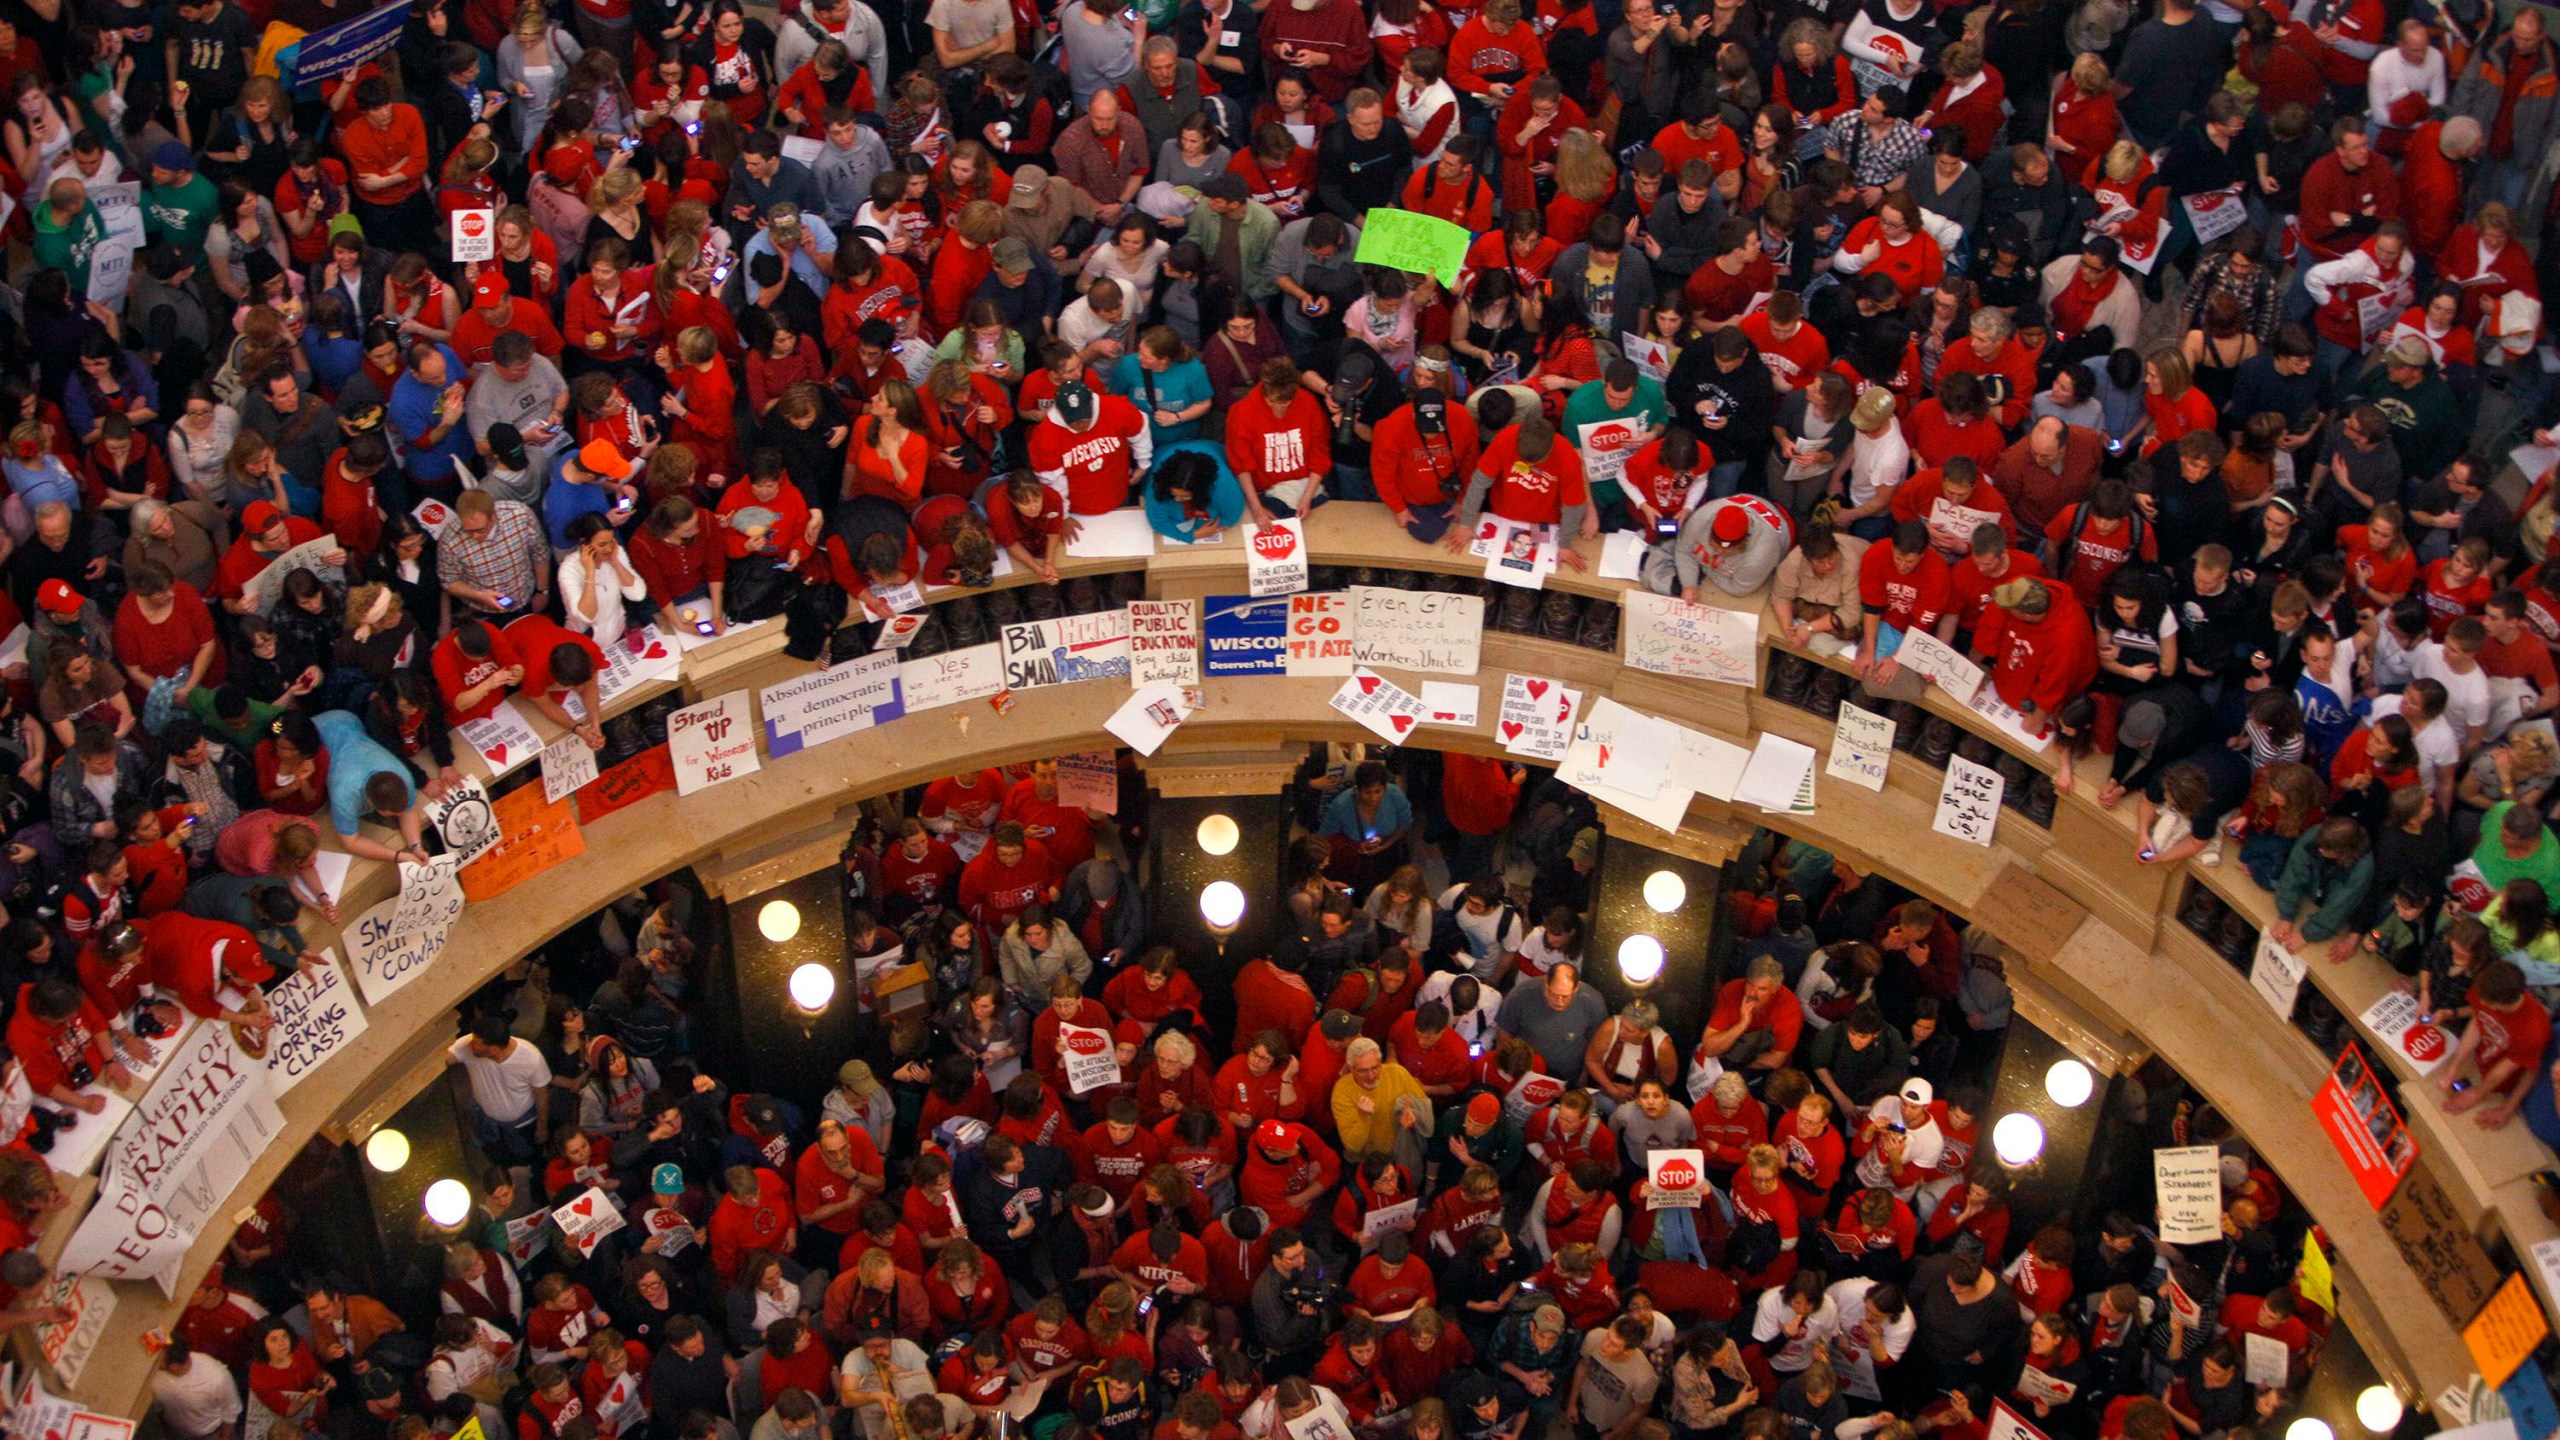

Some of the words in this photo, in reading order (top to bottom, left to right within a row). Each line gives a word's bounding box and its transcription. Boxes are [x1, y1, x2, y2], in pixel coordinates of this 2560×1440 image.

[461, 220, 485, 230] STOP
[101, 257, 124, 273] MTI
[1591, 431, 1630, 449] STOP
[419, 506, 446, 521] STOP
[1255, 533, 1294, 552] STOP
[1256, 567, 1272, 577] THE
[1273, 564, 1300, 576] ATTACK
[1252, 577, 1265, 587] ON
[1265, 573, 1305, 585] WISCONSIN
[1131, 602, 1192, 616] QUALITY
[1293, 596, 1345, 614] NE-
[1361, 589, 1410, 614] Even
[1420, 594, 1465, 615] GM
[1133, 616, 1188, 632] PUBLIC
[1293, 616, 1340, 636] GO
[1005, 625, 1047, 655] Bill
[1131, 634, 1197, 651] EDUCATION
[1352, 643, 1419, 667] Workers
[1911, 636, 1973, 687] RECALL
[933, 655, 970, 675] Yes
[1209, 660, 1255, 671] Deserves
[1255, 658, 1275, 669] The
[763, 669, 850, 706] Absolutism
[854, 662, 868, 677] is
[871, 656, 900, 672] not
[1508, 674, 1523, 686] Care
[777, 713, 786, 724] a
[802, 680, 888, 715] democratic
[1506, 687, 1525, 699] about
[1504, 700, 1537, 712] educators
[673, 699, 725, 733] Stand
[802, 702, 874, 737] principle
[1503, 711, 1514, 722] like
[1514, 713, 1530, 725] they
[1530, 715, 1545, 726] care
[704, 716, 733, 743] UP
[1524, 725, 1534, 736] for
[1534, 728, 1550, 739] your
[1535, 738, 1551, 750] child
[685, 755, 699, 766] for
[706, 763, 733, 783] Kids
[437, 788, 481, 826] UNION
[454, 829, 500, 867] BUSTER
[2461, 883, 2485, 904] TOP
[2372, 1004, 2405, 1034] WISCONSIN
[266, 1002, 347, 1071] WORKING
[1069, 1037, 1103, 1049] STOP
[2410, 1028, 2444, 1058] STOP
[286, 1025, 345, 1077] CLASS
[1072, 1058, 1086, 1069] THE
[1086, 1055, 1111, 1068] ATTACK
[1071, 1070, 1081, 1082] ON
[1080, 1064, 1117, 1080] WISCONSIN
[1081, 1073, 1111, 1089] FAMILIES
[115, 1063, 195, 1217] DEPARTMENT
[198, 1029, 226, 1065] OF
[161, 1073, 248, 1179] Wisconsin-Madison
[1659, 1170, 1695, 1186] STOP
[556, 1209, 572, 1224] Care
[1138, 1265, 1184, 1282] NIKE
